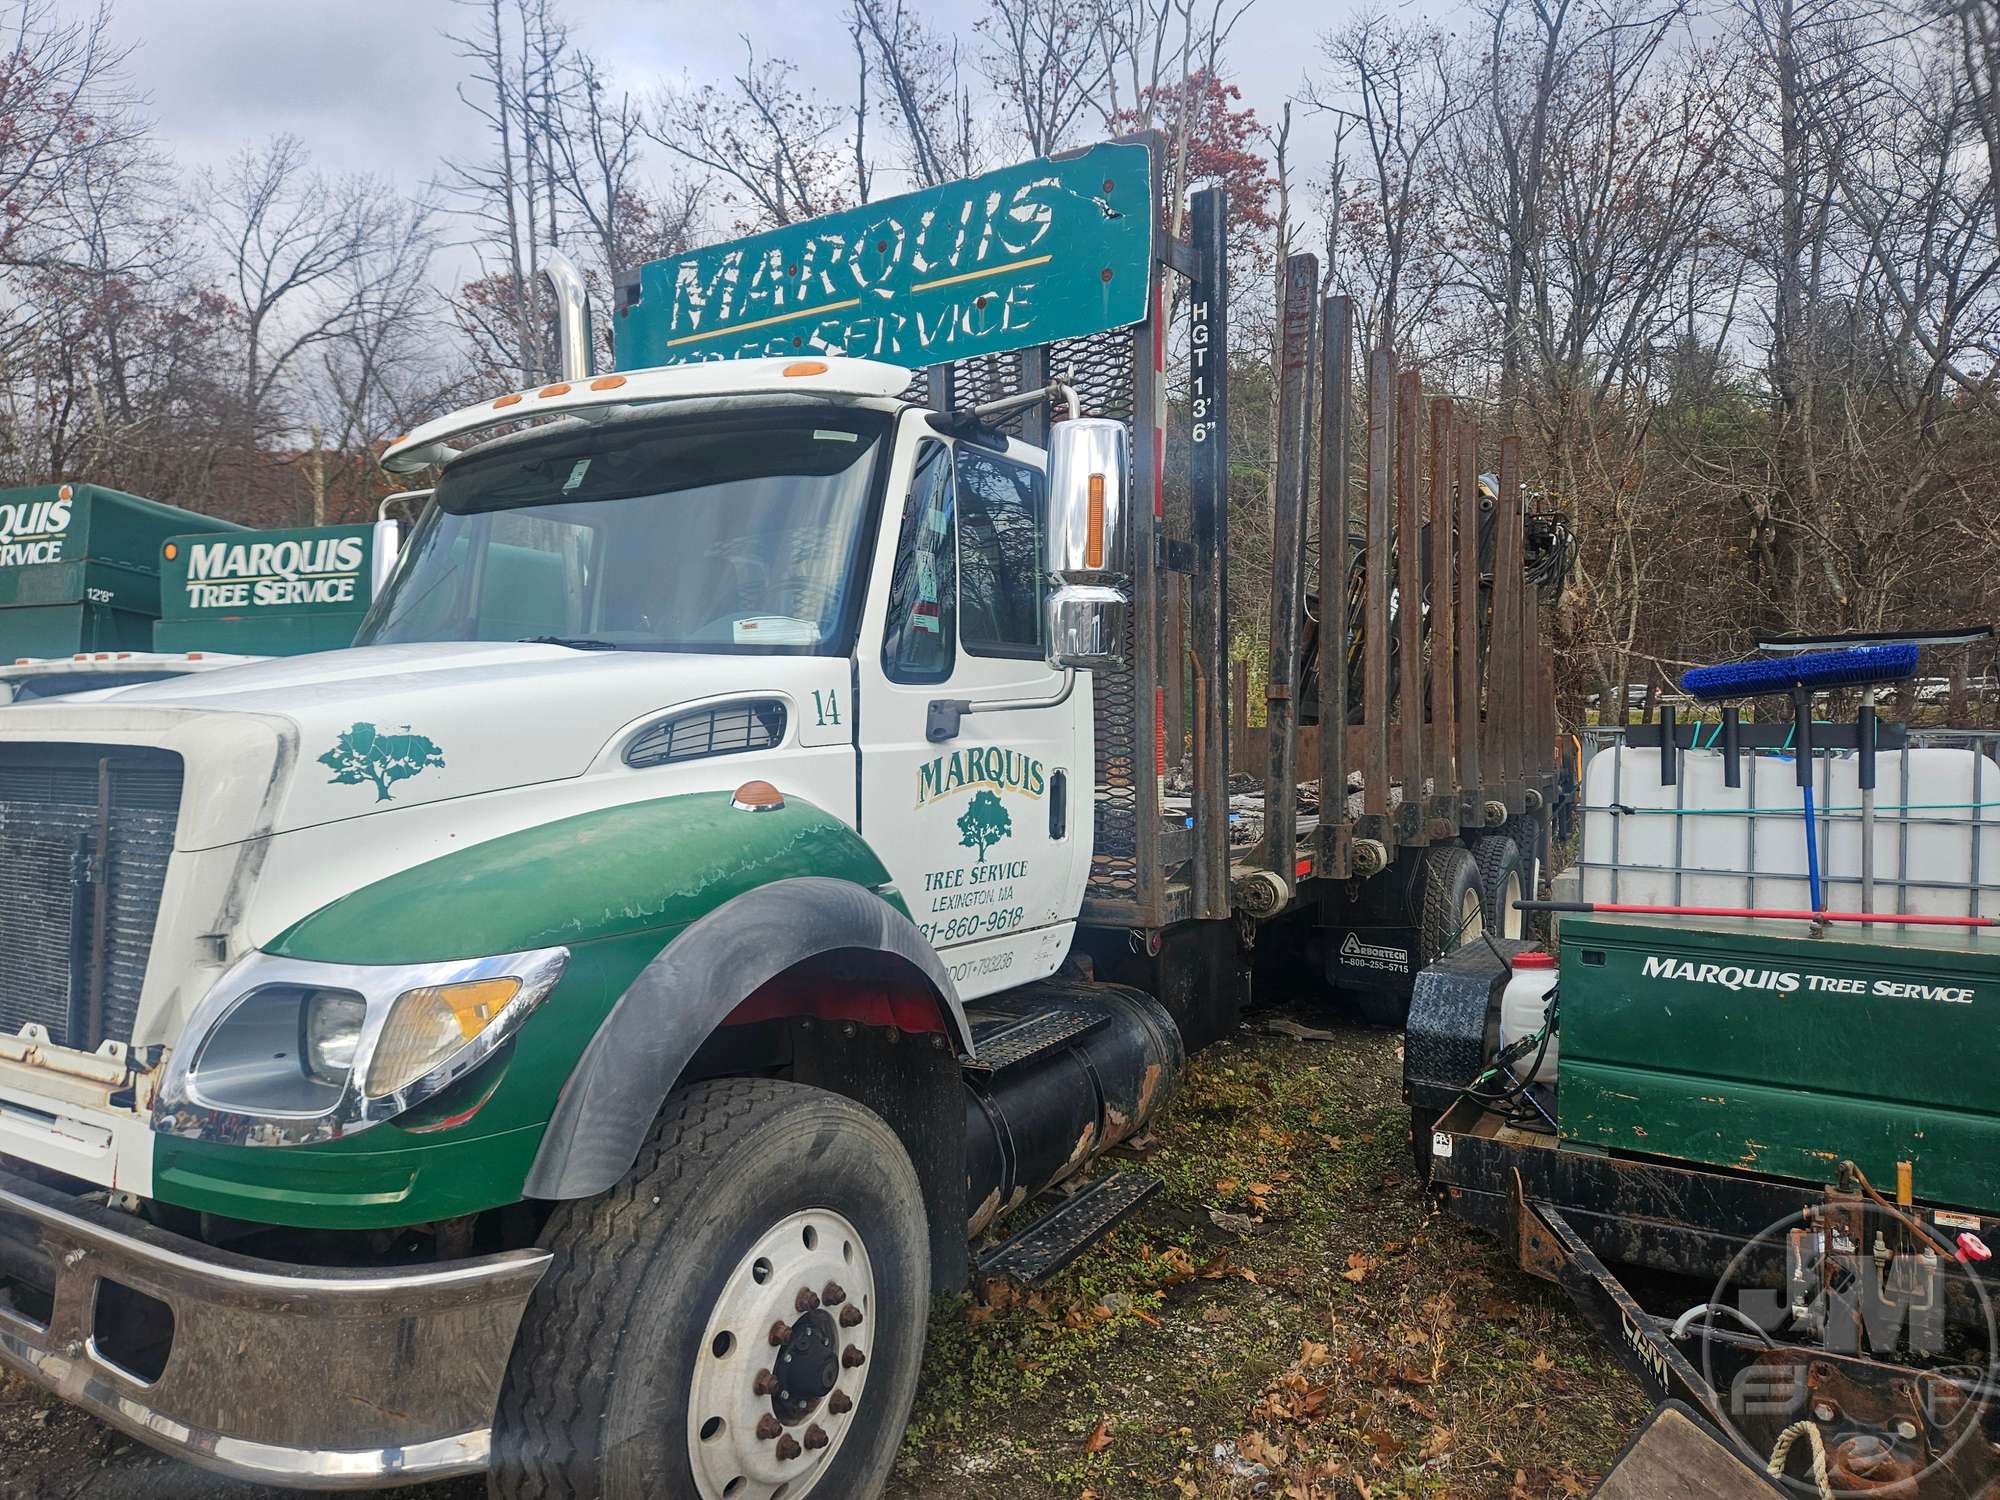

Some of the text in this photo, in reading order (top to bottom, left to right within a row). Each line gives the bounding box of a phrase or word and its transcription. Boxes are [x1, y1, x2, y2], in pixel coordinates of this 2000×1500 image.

[669, 177, 1061, 331] MARQUIS
[808, 284, 1038, 358] SERVICE
[0, 540, 63, 567] RVICE
[186, 536, 363, 582] MARQUIS
[186, 578, 356, 608] TREE SERVICE
[811, 688, 842, 726] 14
[918, 746, 1045, 805] MARQUIS
[925, 860, 1029, 892] TREE SERVICE
[998, 885, 1014, 902] MA
[917, 906, 1024, 944] 81-860-9618
[1340, 957, 1409, 974] 1-800-255-5715
[1344, 937, 1406, 960] ARBORTECH
[1641, 956, 1975, 1004] MARQUIS TREE SERVICE
